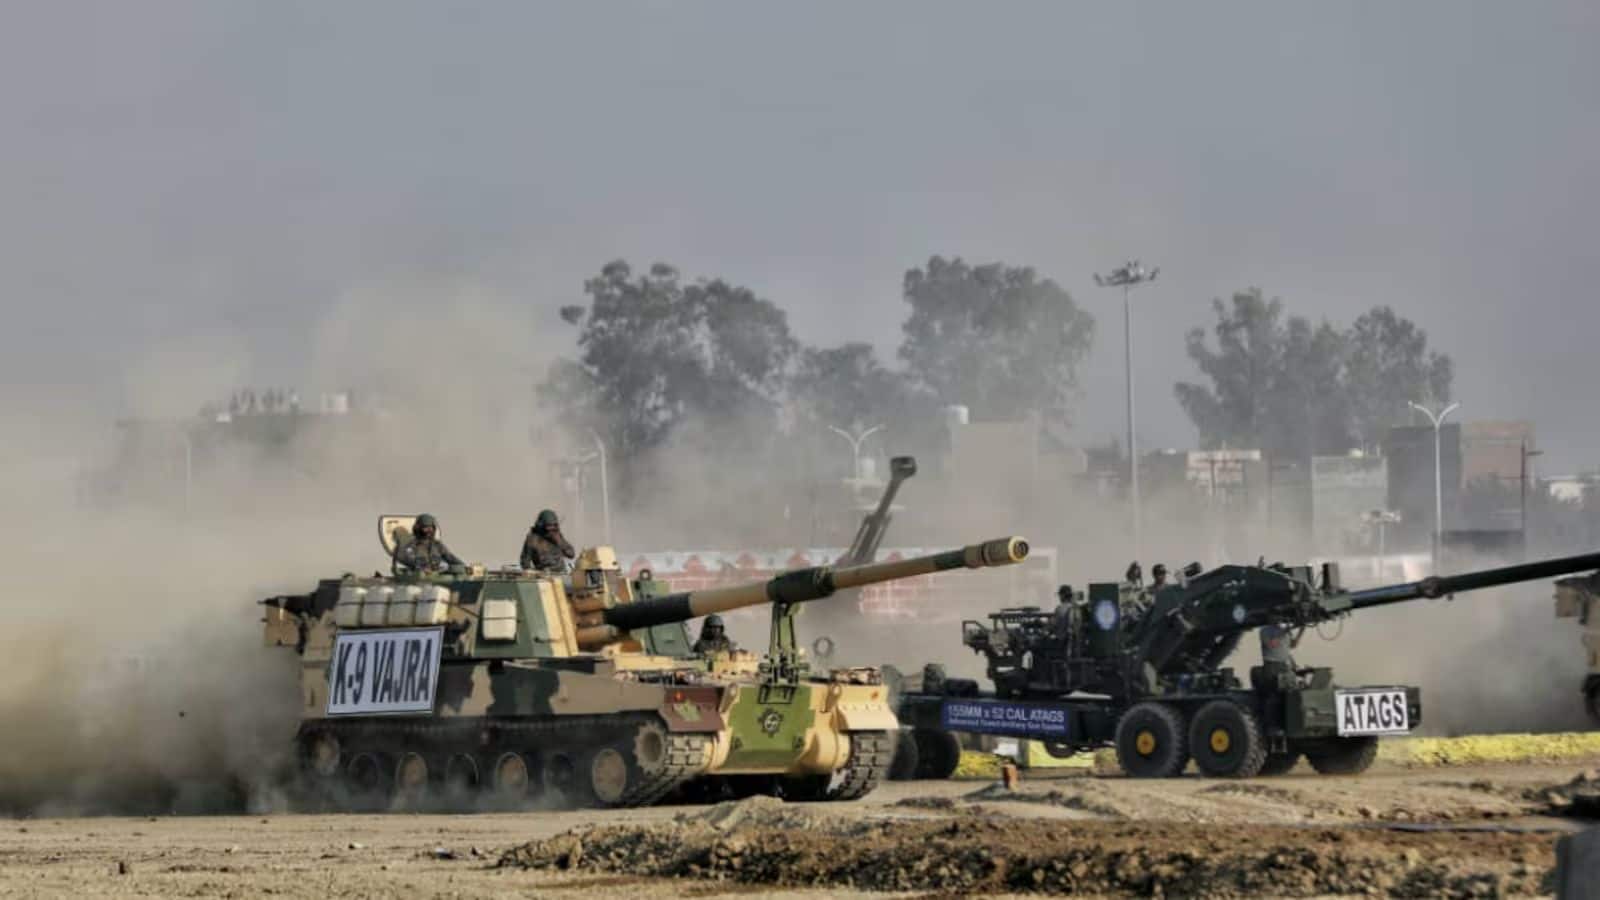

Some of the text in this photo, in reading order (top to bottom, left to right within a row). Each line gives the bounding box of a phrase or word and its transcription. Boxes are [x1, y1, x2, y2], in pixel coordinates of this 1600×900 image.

[332, 638, 433, 705] K-9 VAJRA
[948, 705, 982, 718] 155MM
[992, 706, 1004, 720] 52
[1006, 708, 1028, 721] CAL
[1030, 709, 1065, 723] ATAGS
[1344, 694, 1404, 729] ATAGS
